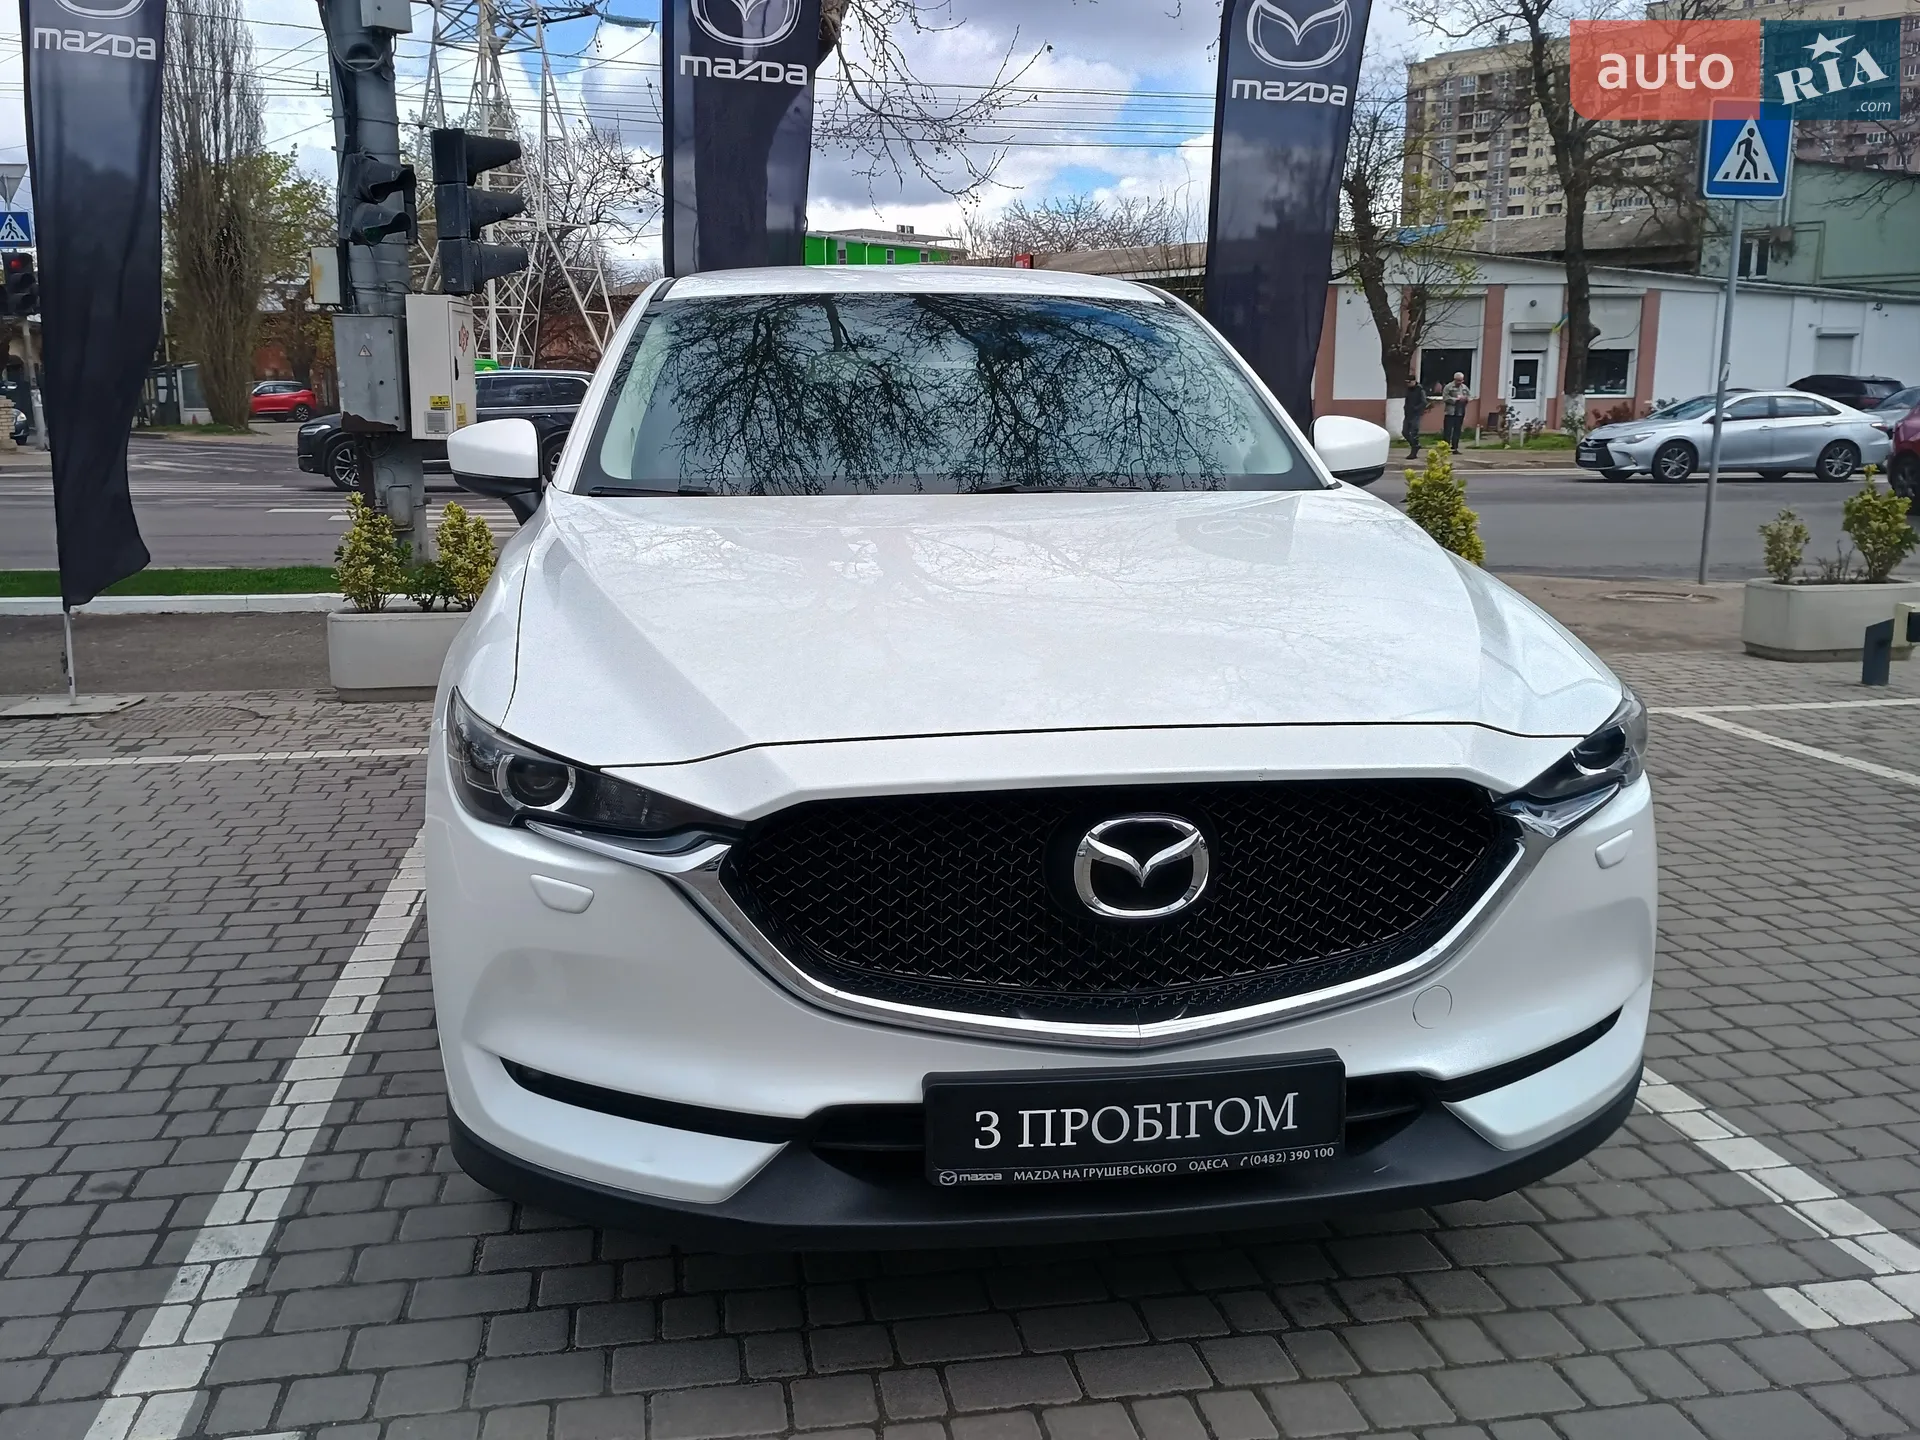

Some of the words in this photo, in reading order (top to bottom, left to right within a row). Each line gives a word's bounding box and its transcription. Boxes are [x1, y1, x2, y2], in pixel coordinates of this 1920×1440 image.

[1017, 1092, 1299, 1148] ПРОБІГОМ
[1013, 1170, 1060, 1181] MAZDA
[1062, 1168, 1081, 1179] НА
[1083, 1162, 1177, 1179] ГРУШЕВСЬКОГО
[1188, 1158, 1229, 1172] ОДЕСА
[1250, 1151, 1287, 1166] (0482)
[1289, 1150, 1311, 1162] 390
[1313, 1147, 1335, 1159] 100
